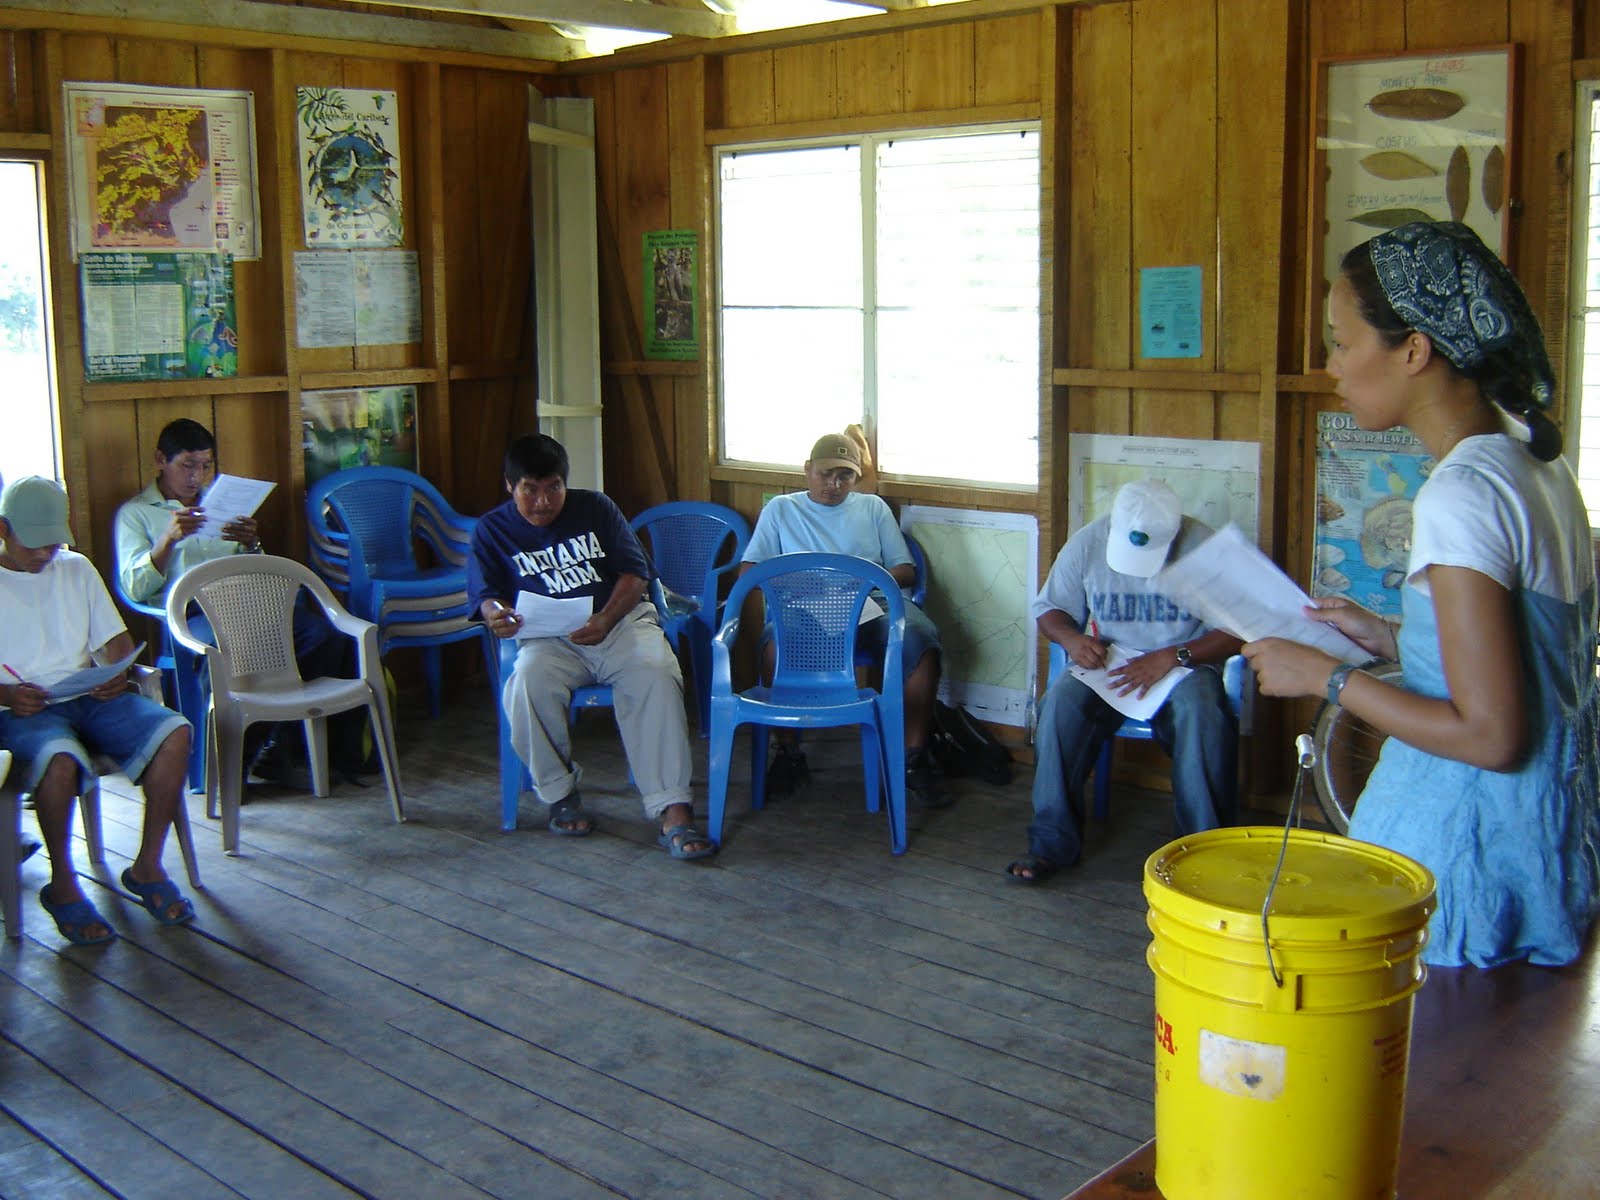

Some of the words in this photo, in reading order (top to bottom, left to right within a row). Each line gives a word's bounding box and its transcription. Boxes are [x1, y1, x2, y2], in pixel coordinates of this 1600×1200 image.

[1363, 434, 1376, 443] or
[1378, 434, 1421, 446] JEWFIS
[512, 531, 606, 577] INDIANA
[540, 560, 602, 594] MOM
